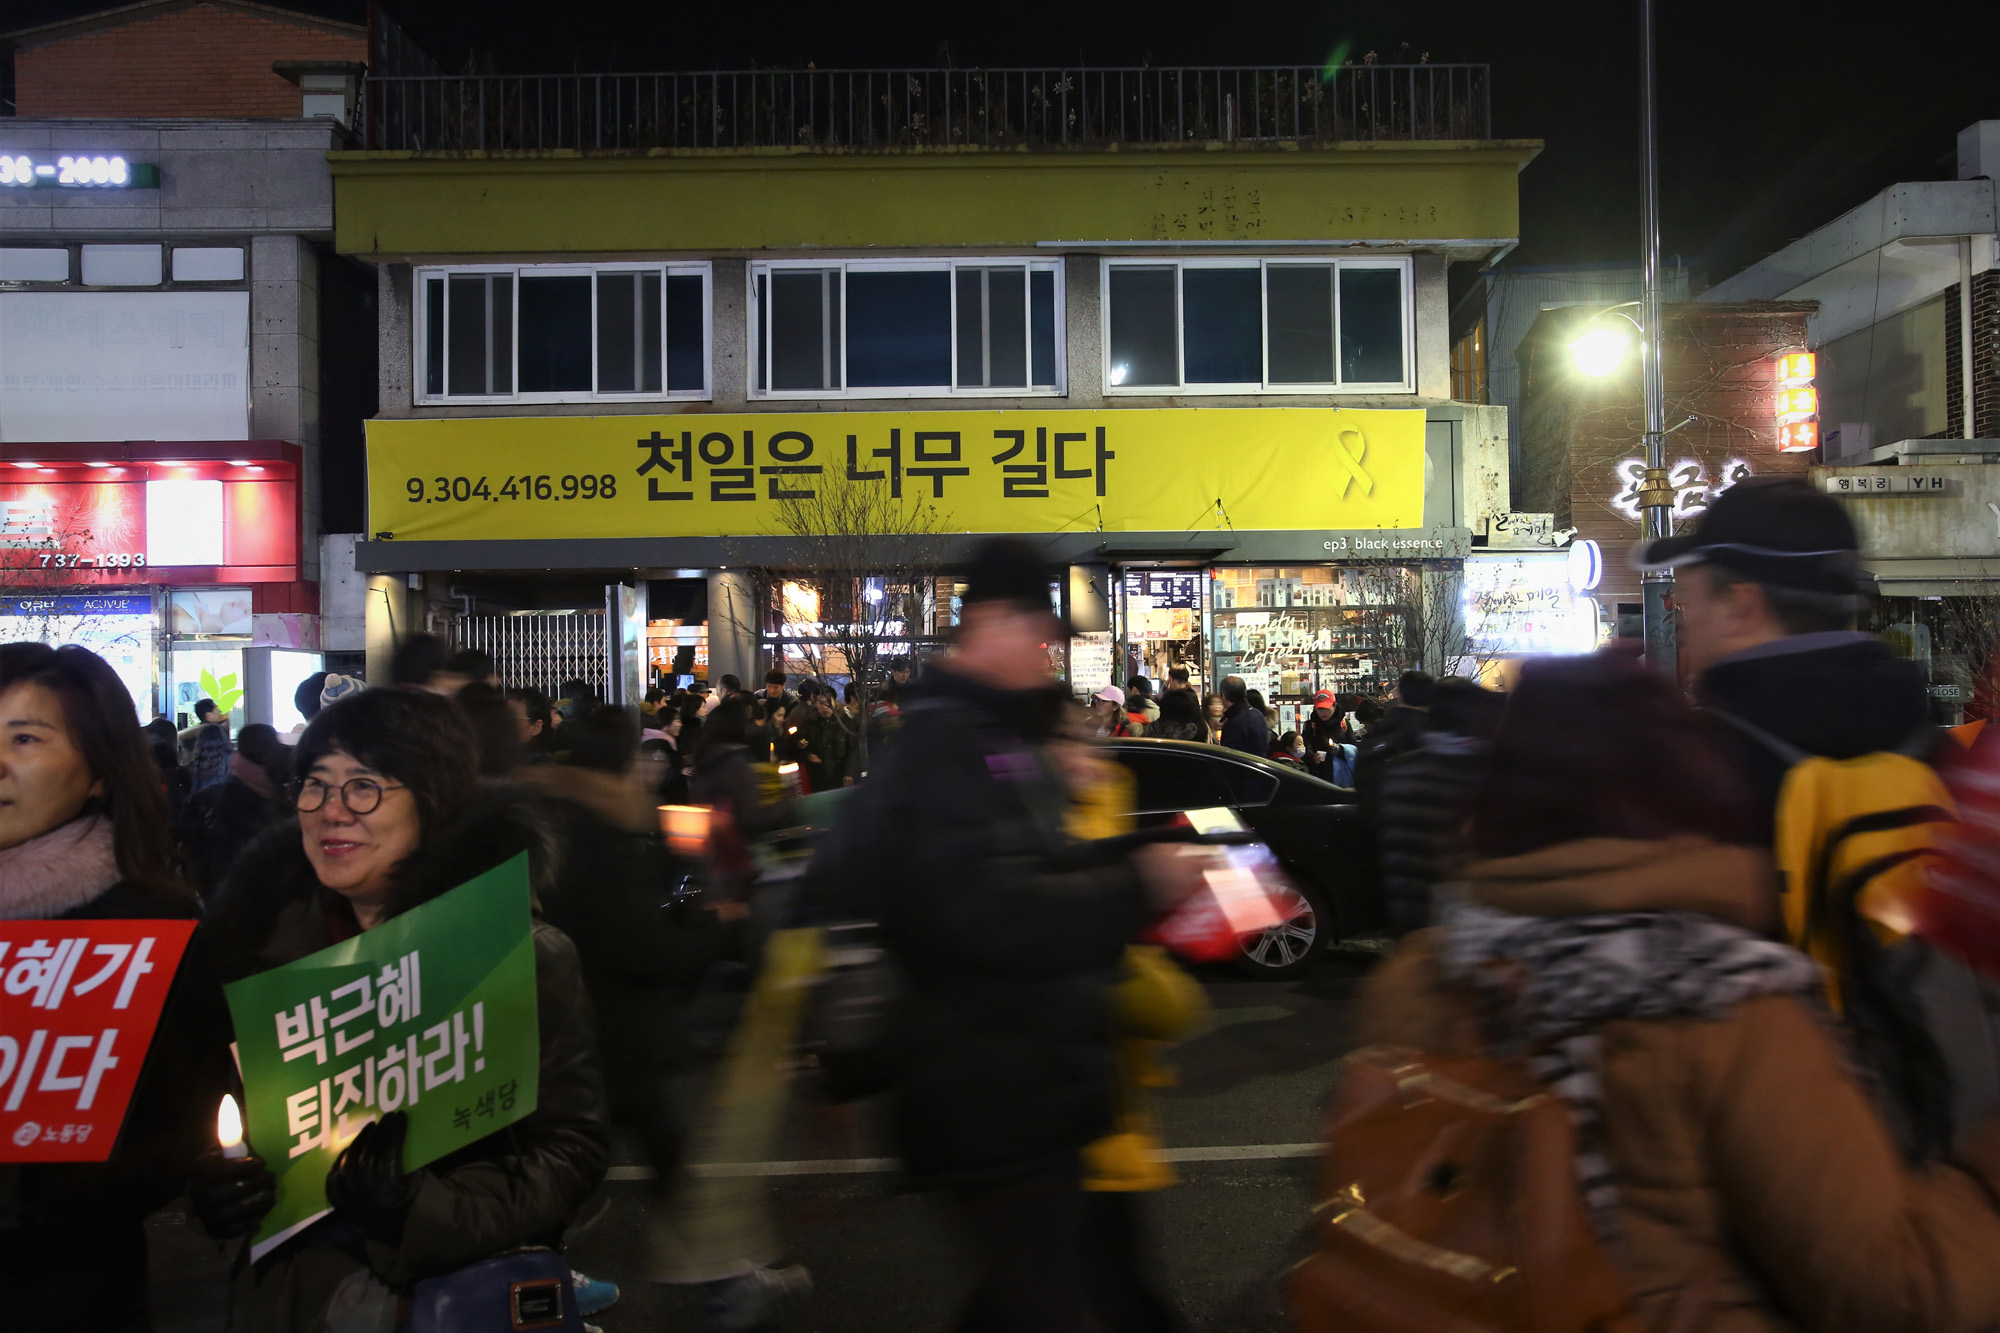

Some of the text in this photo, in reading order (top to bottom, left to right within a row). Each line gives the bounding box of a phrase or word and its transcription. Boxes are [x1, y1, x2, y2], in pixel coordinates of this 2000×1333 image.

[636, 426, 1115, 502] 천일은 너무 길다
[406, 474, 617, 503] 9.304.416.998
[1839, 477, 1943, 490] 행복궁 YH
[1355, 537, 1389, 549] black
[1392, 538, 1443, 549] essence
[1513, 517, 1552, 545] 메밀
[39, 552, 145, 568] 737-1393
[84, 599, 129, 609] ACUVUE
[1526, 587, 1561, 609] 메밀
[1240, 640, 1295, 671] Coffee
[0, 937, 157, 1010] 혜가
[274, 950, 422, 1065] 박근혜
[286, 1002, 486, 1160] 퇴진하라!
[451, 1078, 519, 1131] 녹색당
[41, 1123, 94, 1143] 노동당
